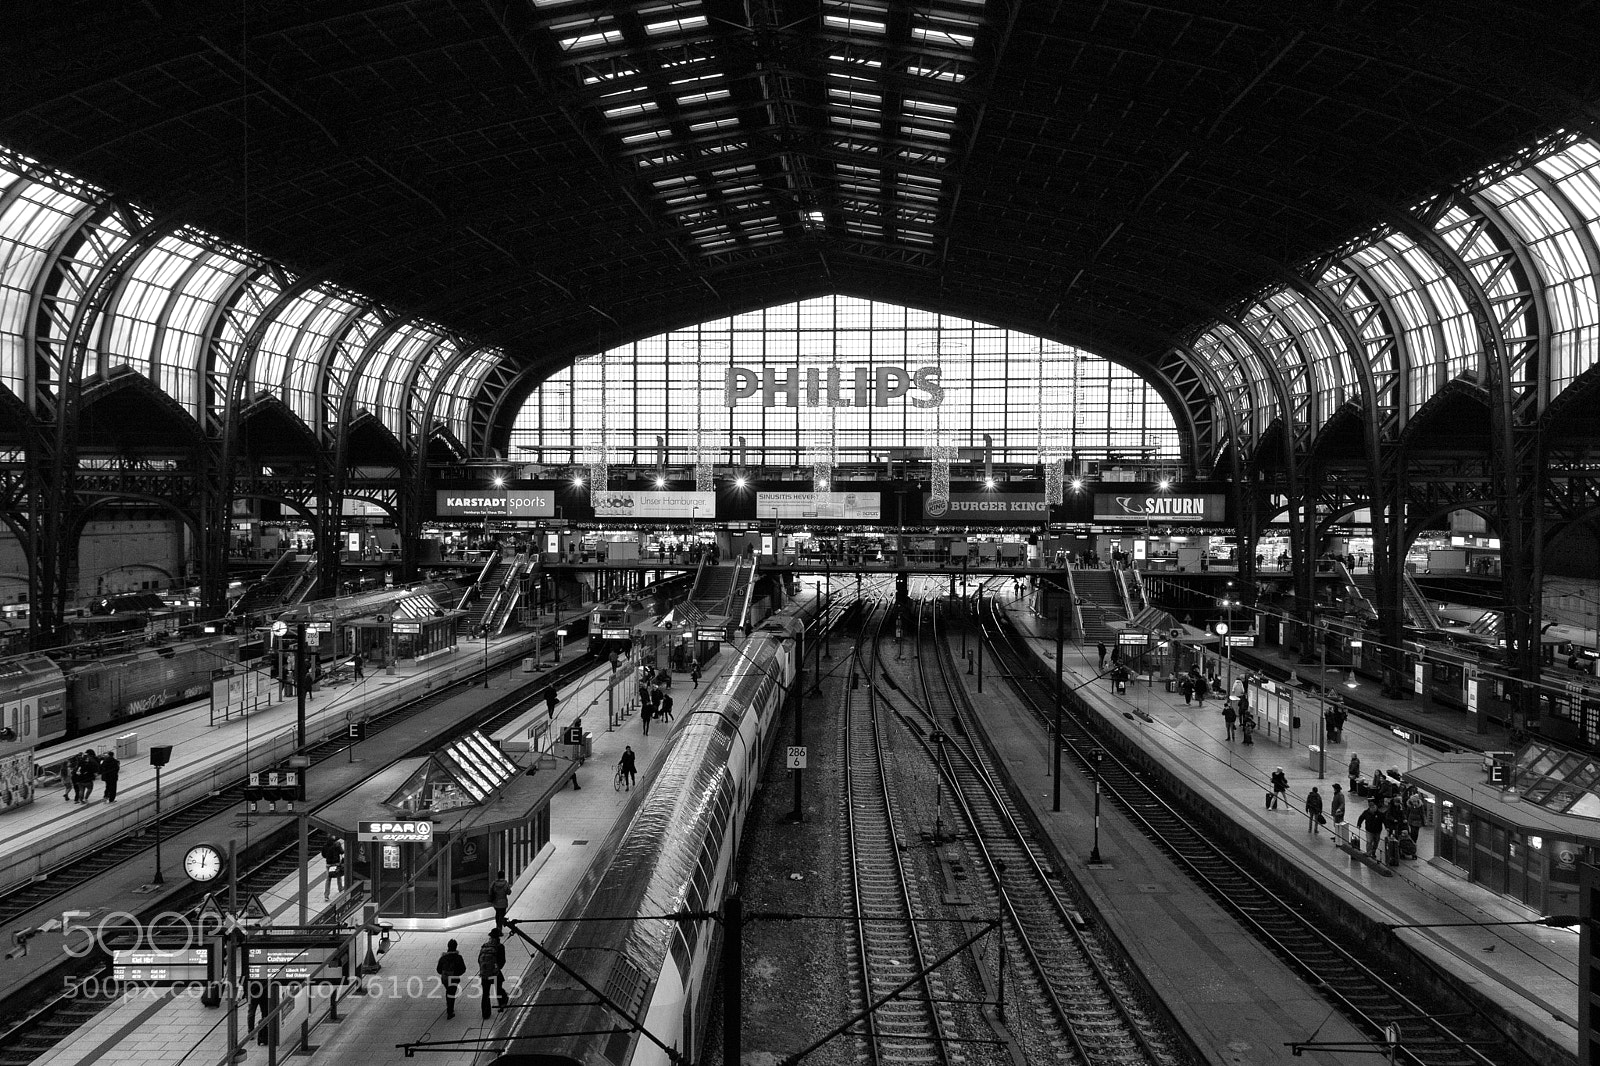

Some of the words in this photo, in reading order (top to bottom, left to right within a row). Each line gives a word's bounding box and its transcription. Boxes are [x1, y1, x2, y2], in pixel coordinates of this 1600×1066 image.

[724, 366, 945, 408] PHILIPS
[446, 497, 507, 507] KARSTADT
[509, 496, 546, 509] sports
[640, 497, 660, 505] Unser
[950, 501, 1007, 511] BURGER
[1010, 501, 1046, 511] KING
[1145, 497, 1204, 514] SATURN
[350, 724, 358, 737] E
[570, 729, 579, 742] E
[789, 747, 805, 756] 286
[793, 757, 800, 766] 6
[1492, 766, 1502, 781] E
[370, 823, 415, 833] SPAR
